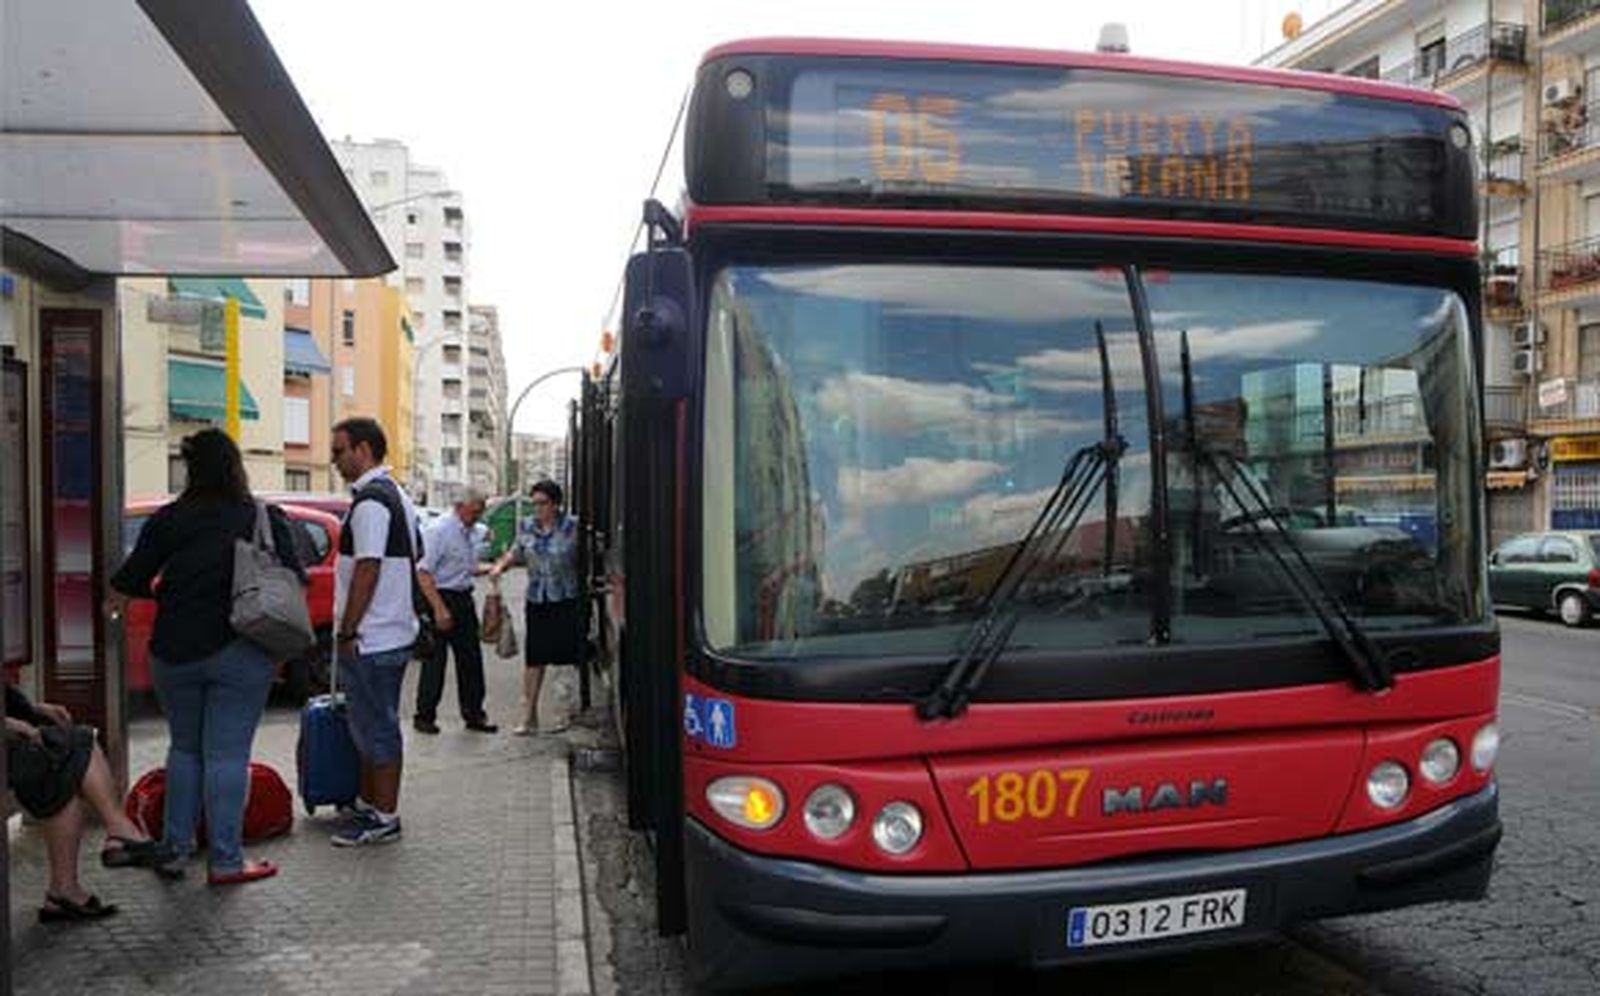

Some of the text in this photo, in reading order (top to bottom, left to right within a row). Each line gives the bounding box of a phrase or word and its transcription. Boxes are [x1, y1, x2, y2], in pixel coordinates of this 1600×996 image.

[968, 768, 1091, 825] 1807
[1103, 778, 1228, 815] MAN
[1091, 893, 1240, 939] 0312 FRK
